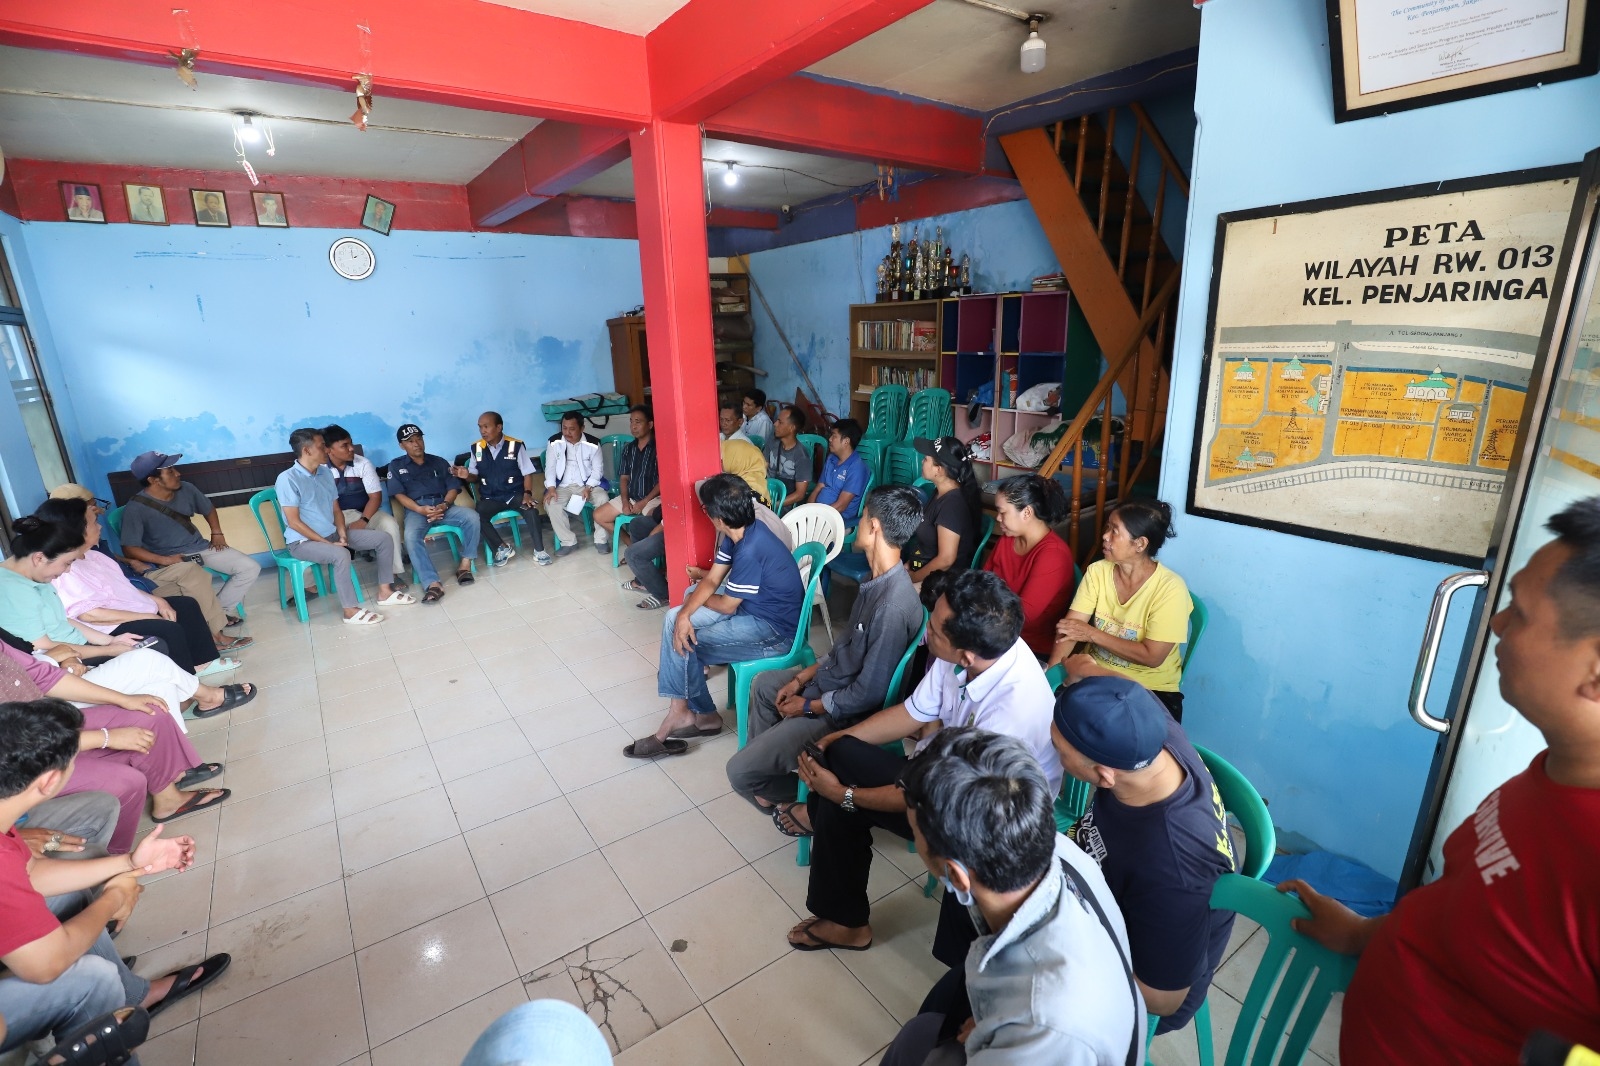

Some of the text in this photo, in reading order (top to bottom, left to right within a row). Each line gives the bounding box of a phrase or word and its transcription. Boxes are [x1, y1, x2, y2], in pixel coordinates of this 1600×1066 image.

[1404, 2, 1438, 14] Community
[1384, 220, 1485, 248] PETA
[1305, 245, 1554, 280] WILAYAH RW. 013
[1302, 286, 1352, 306] KEL.
[1090, 828, 1107, 860] PANITIA
